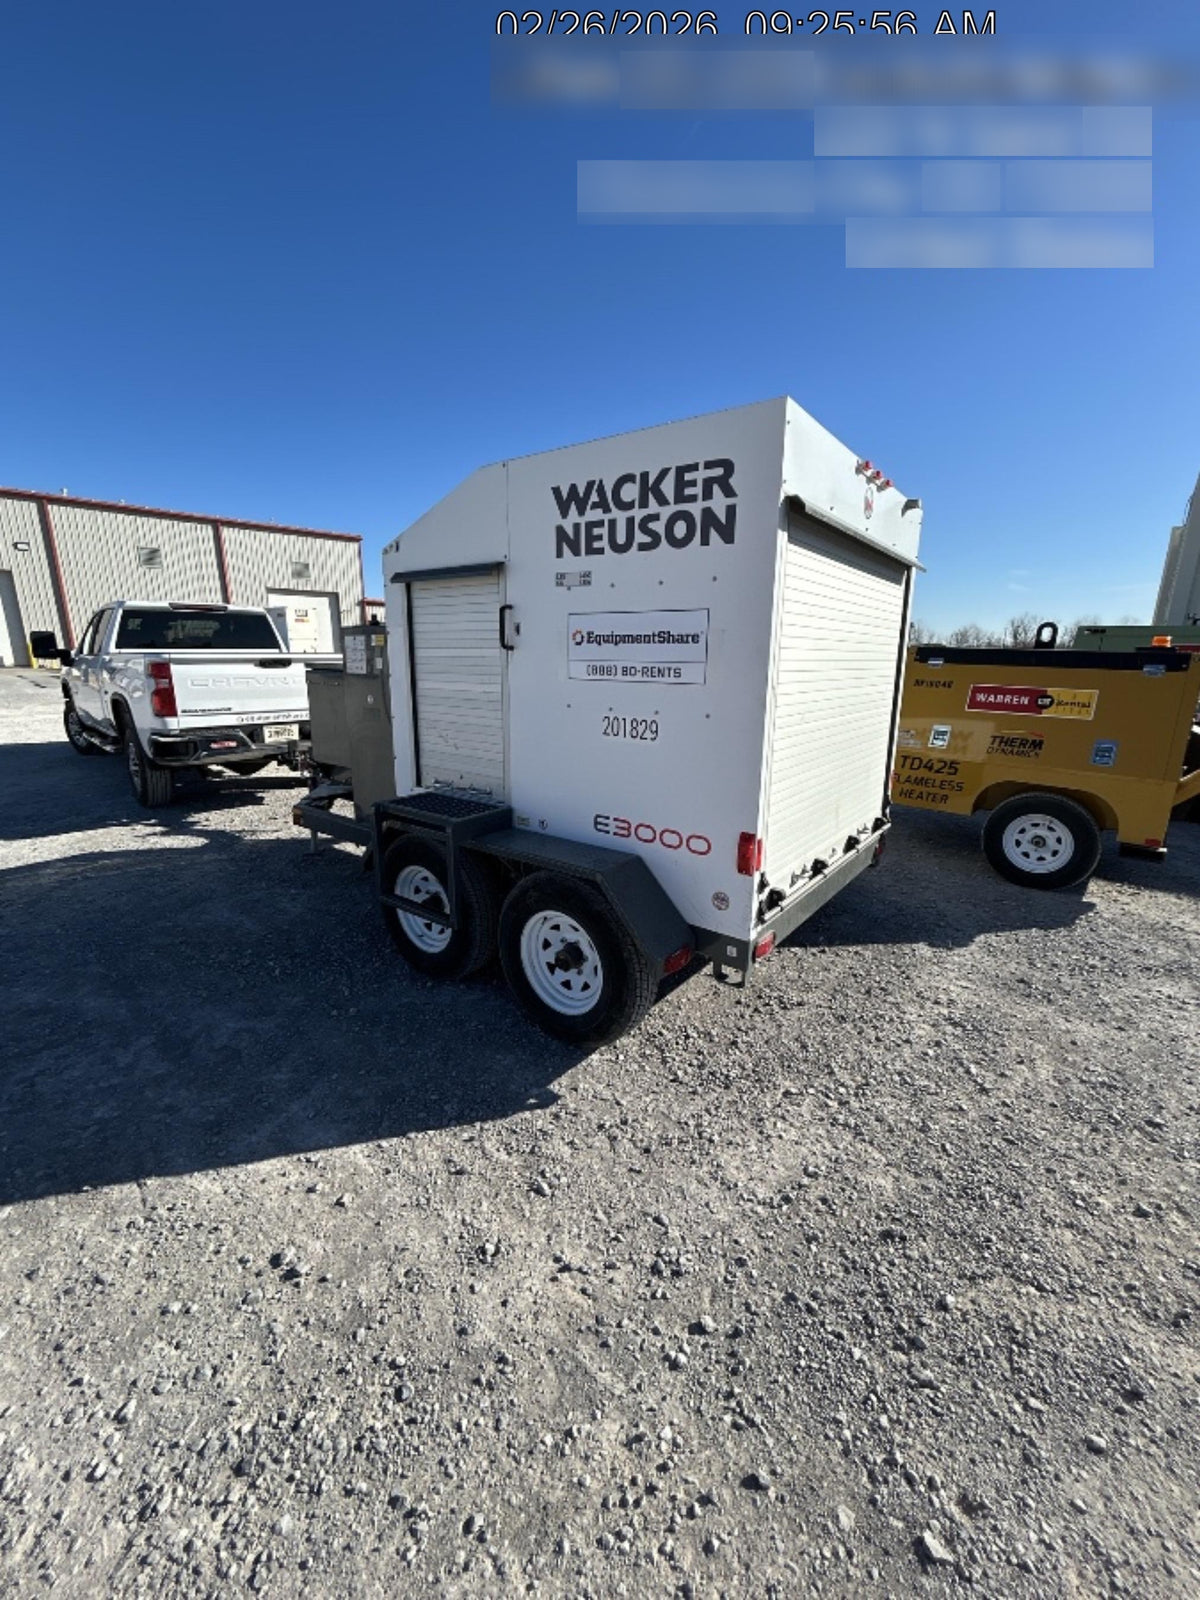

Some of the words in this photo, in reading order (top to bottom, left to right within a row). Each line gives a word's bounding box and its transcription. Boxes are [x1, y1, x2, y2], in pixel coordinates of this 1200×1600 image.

[551, 458, 738, 520] WACKER
[555, 503, 737, 558] NEUSON
[586, 630, 701, 646] EquipmentShare
[975, 692, 1030, 705] WARREN
[602, 716, 659, 741] 201829
[990, 735, 1044, 751] THERM
[900, 755, 960, 776] TD425
[899, 787, 949, 805] HEATER
[593, 813, 712, 856] E3000
